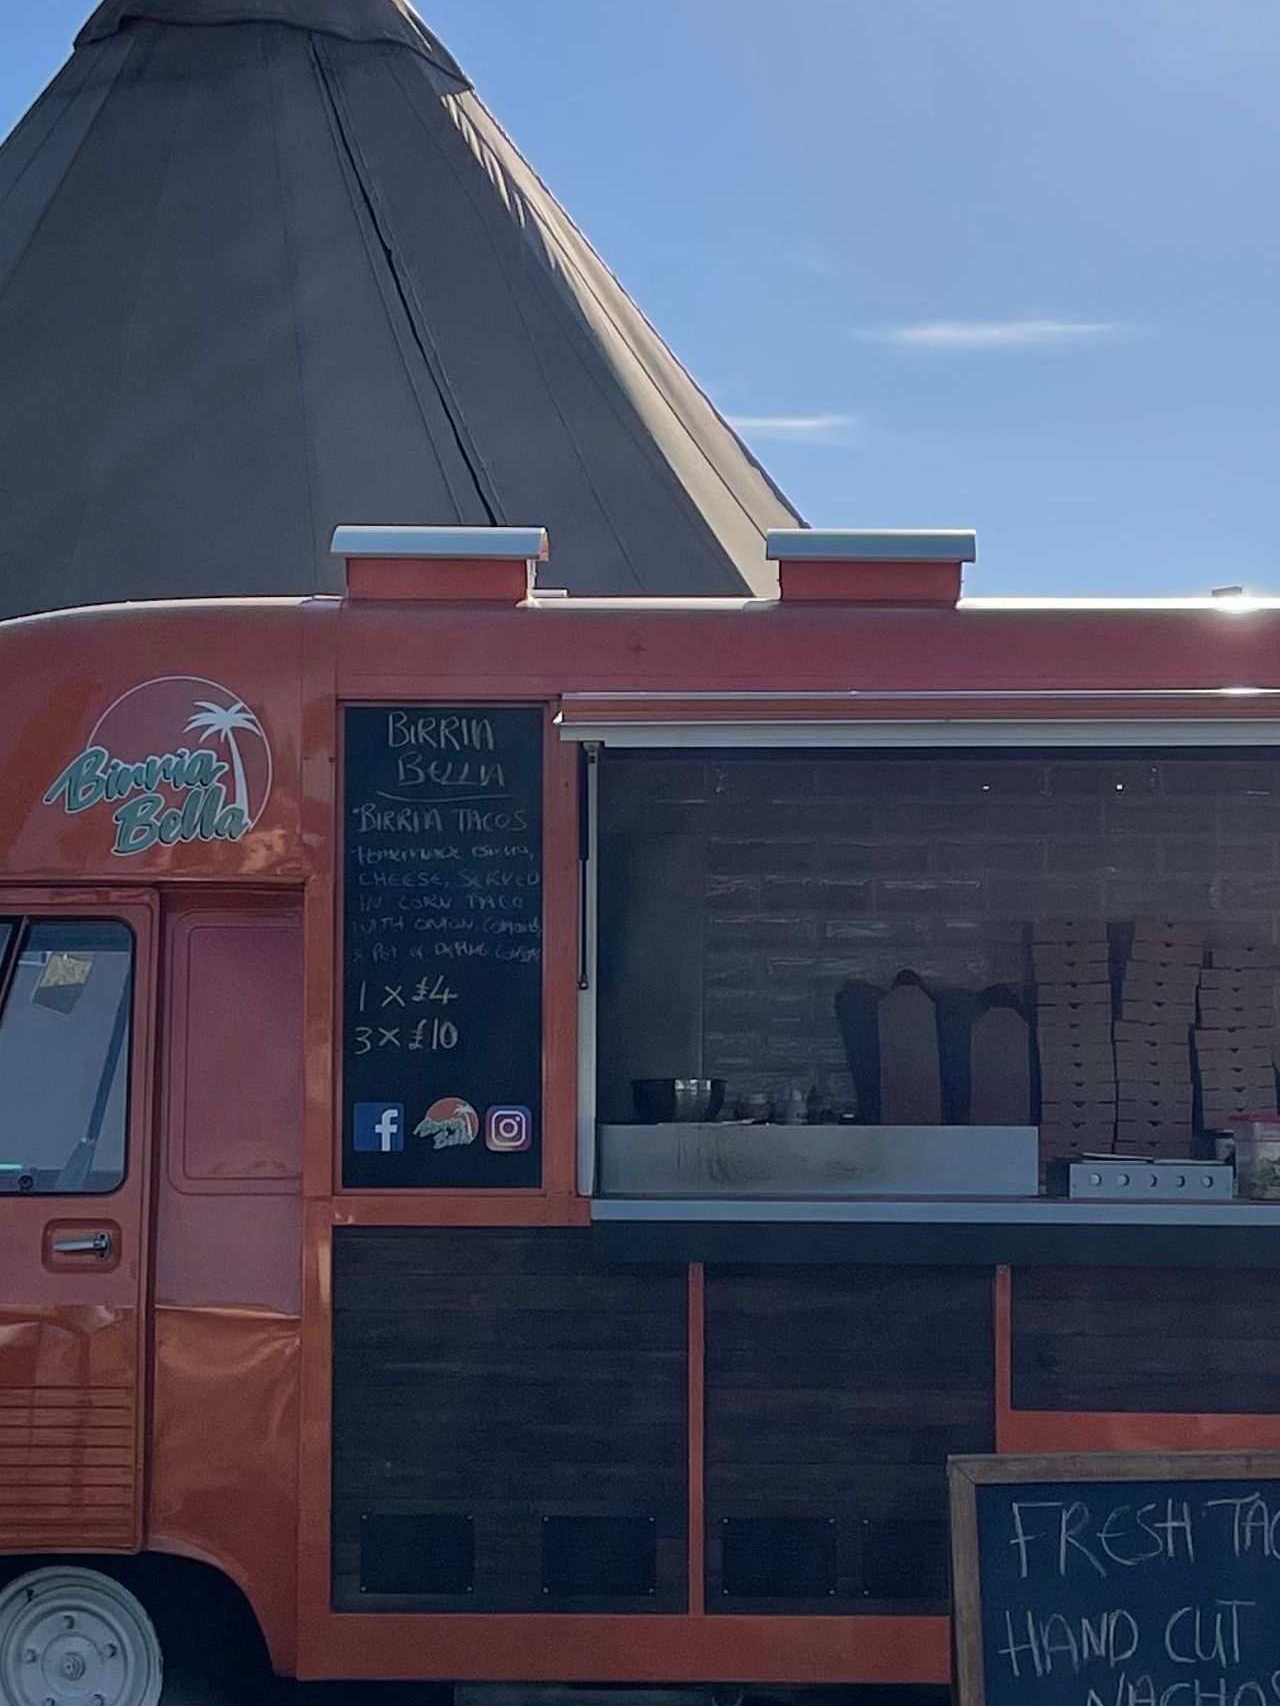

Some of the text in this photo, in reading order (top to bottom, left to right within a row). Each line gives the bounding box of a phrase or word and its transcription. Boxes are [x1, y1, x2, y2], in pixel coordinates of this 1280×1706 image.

[387, 711, 495, 751] BIRRIA
[43, 746, 229, 814] Birria
[111, 784, 251, 857] Bella
[359, 803, 528, 833] BIRRIA TACOS
[398, 893, 453, 910] CORN
[464, 894, 523, 910] TACO
[411, 975, 459, 1005] £4
[354, 1026, 374, 1055] 3
[408, 1019, 459, 1051] £10
[1009, 1496, 1195, 1579] FRESH
[998, 1599, 1257, 1678] HAND CUT
